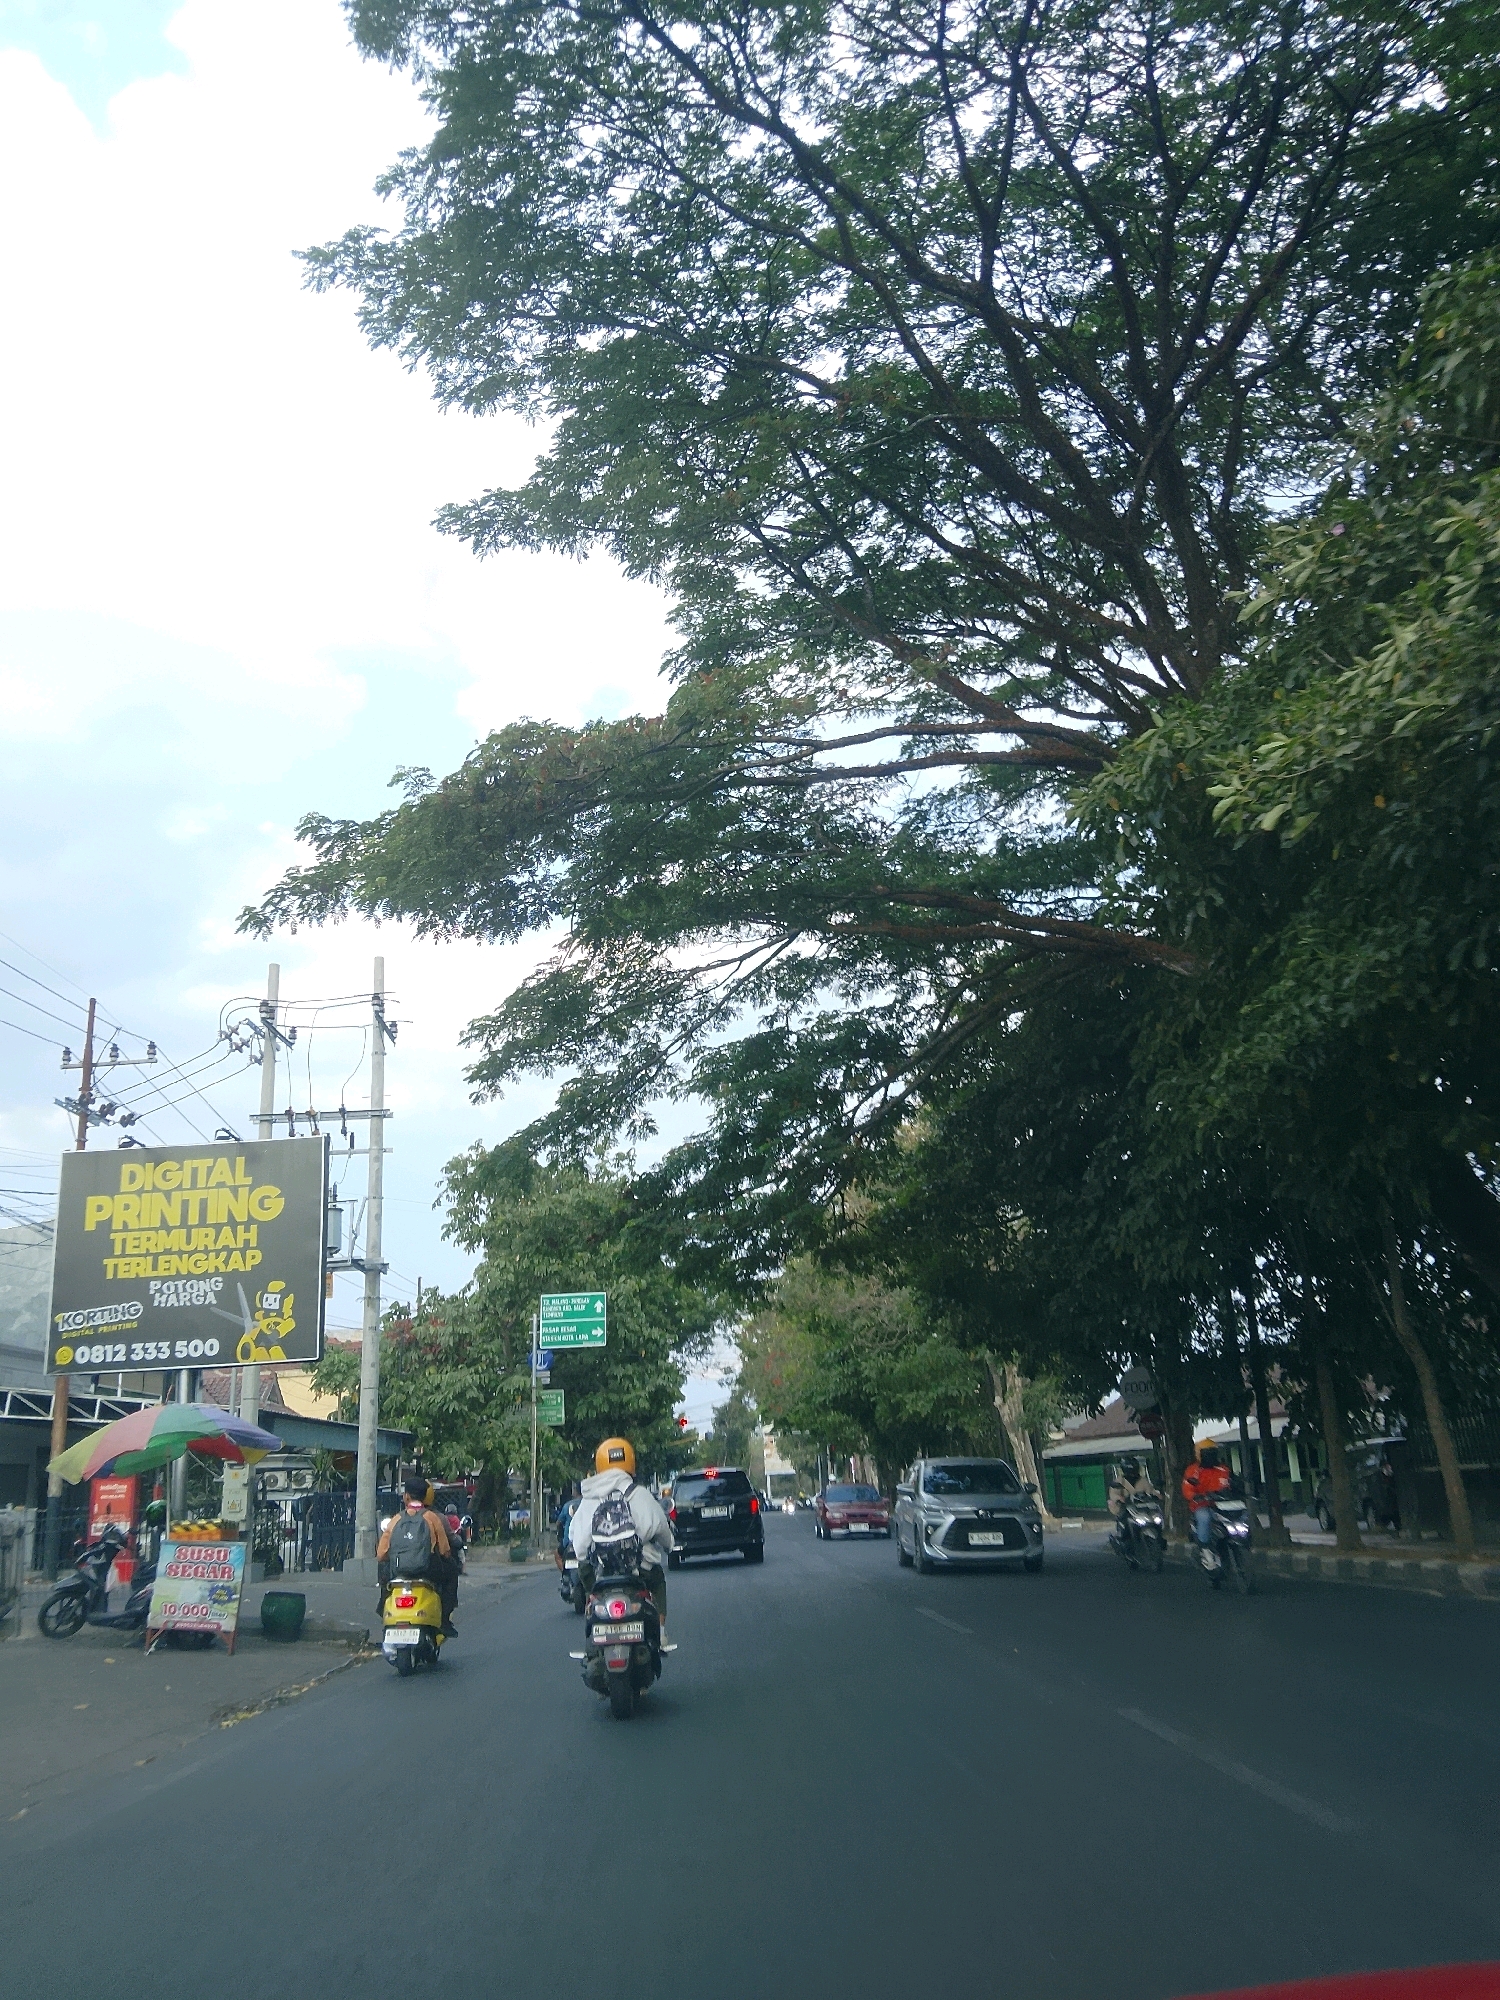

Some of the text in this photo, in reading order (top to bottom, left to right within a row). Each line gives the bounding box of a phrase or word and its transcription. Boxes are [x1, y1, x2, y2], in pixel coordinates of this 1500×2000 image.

[120, 1157, 253, 1193] DIGITAL
[84, 1185, 285, 1231] PRINTING
[110, 1225, 258, 1255] TERMURAH
[103, 1250, 262, 1280] TERLENGKAP
[149, 1276, 223, 1295] POTONG
[153, 1291, 217, 1308] HARGA
[57, 1301, 144, 1331] KORTING
[62, 1321, 138, 1340] DIGITAL PRINTING
[75, 1338, 220, 1364] 0812 333 500
[175, 1545, 230, 1563] SUSU
[166, 1562, 235, 1581] SEGAR
